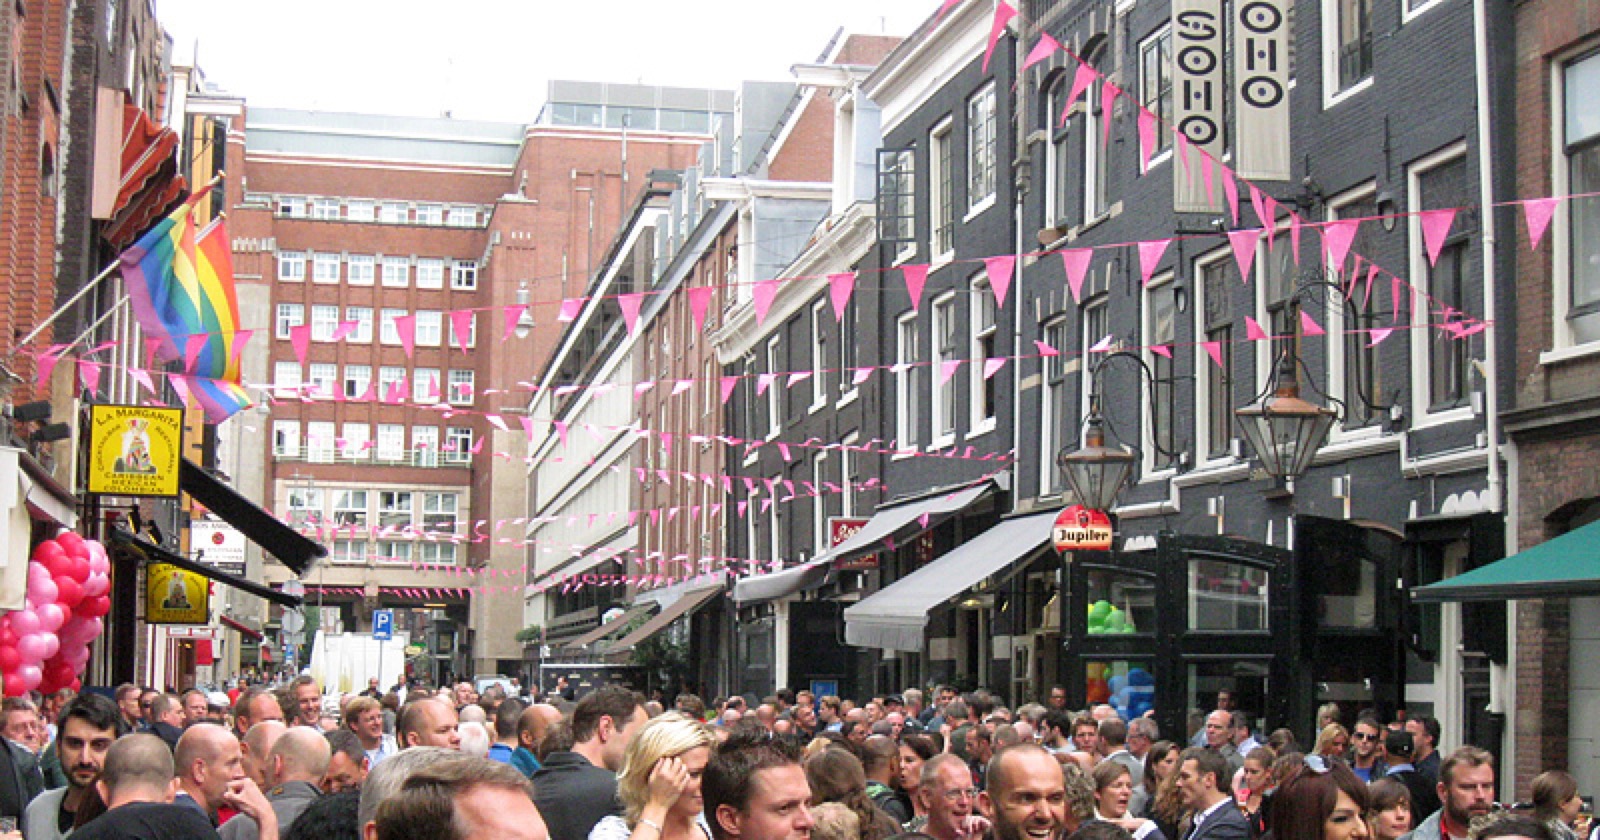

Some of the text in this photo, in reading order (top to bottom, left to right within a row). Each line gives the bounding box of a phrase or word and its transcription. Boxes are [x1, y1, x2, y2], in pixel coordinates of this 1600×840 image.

[1239, 1, 1284, 108] OHO
[1177, 10, 1218, 145] SOHO
[95, 409, 179, 431] LA MARGARITA
[1059, 529, 1109, 544] Jupiler
[377, 613, 389, 629] P
